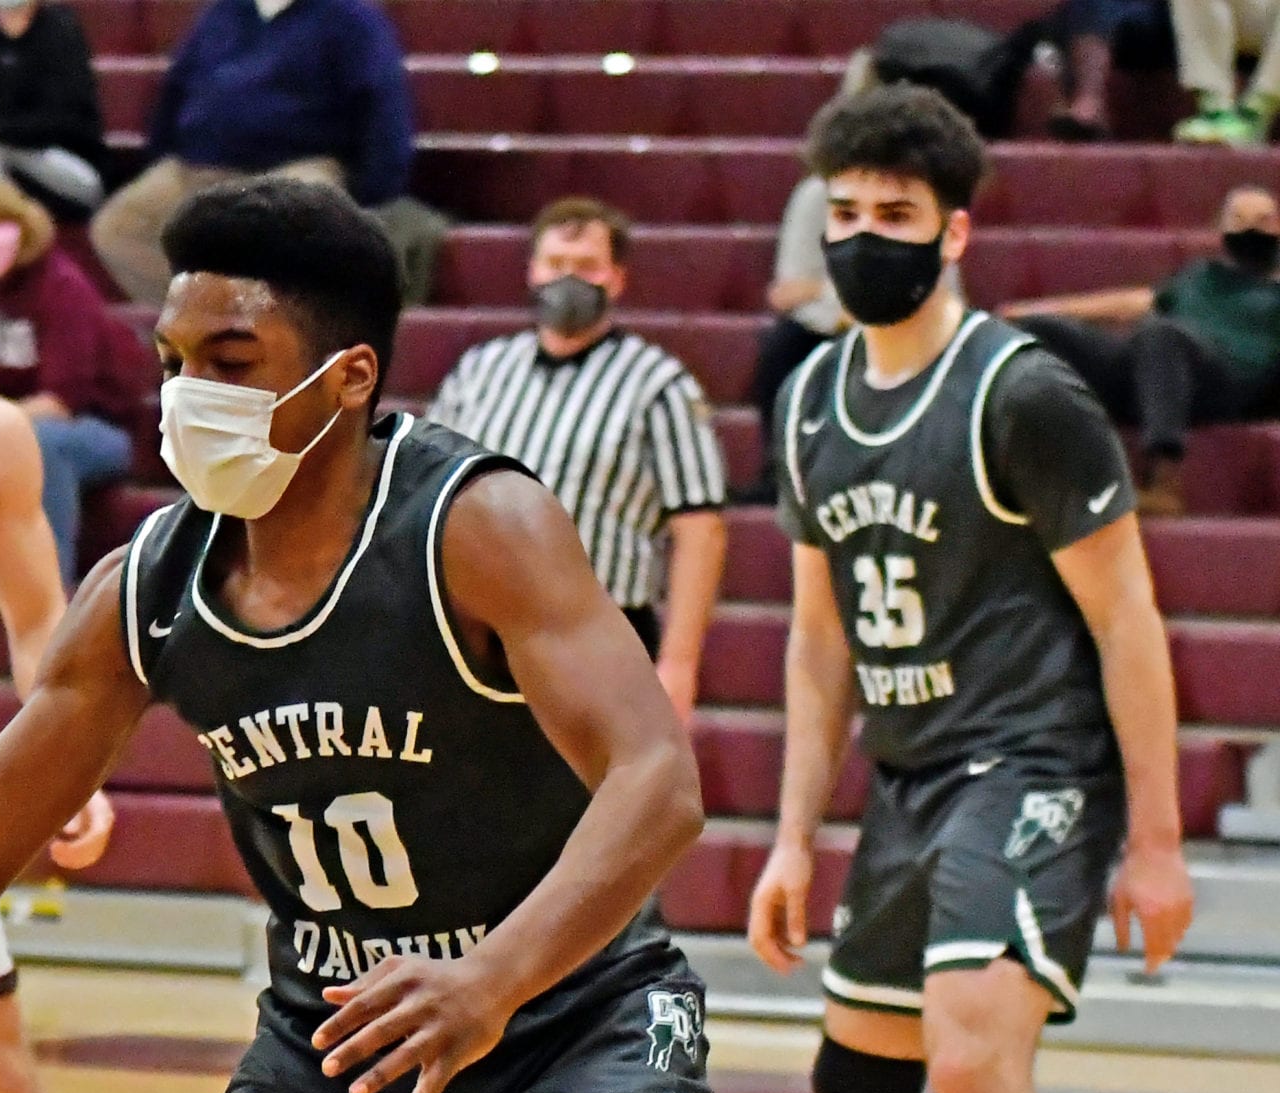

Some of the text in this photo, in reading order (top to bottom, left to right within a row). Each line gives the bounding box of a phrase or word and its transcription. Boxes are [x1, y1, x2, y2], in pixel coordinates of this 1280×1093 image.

[817, 482, 940, 542] CENTRAL
[854, 556, 925, 648] 35
[272, 791, 419, 912] 10
